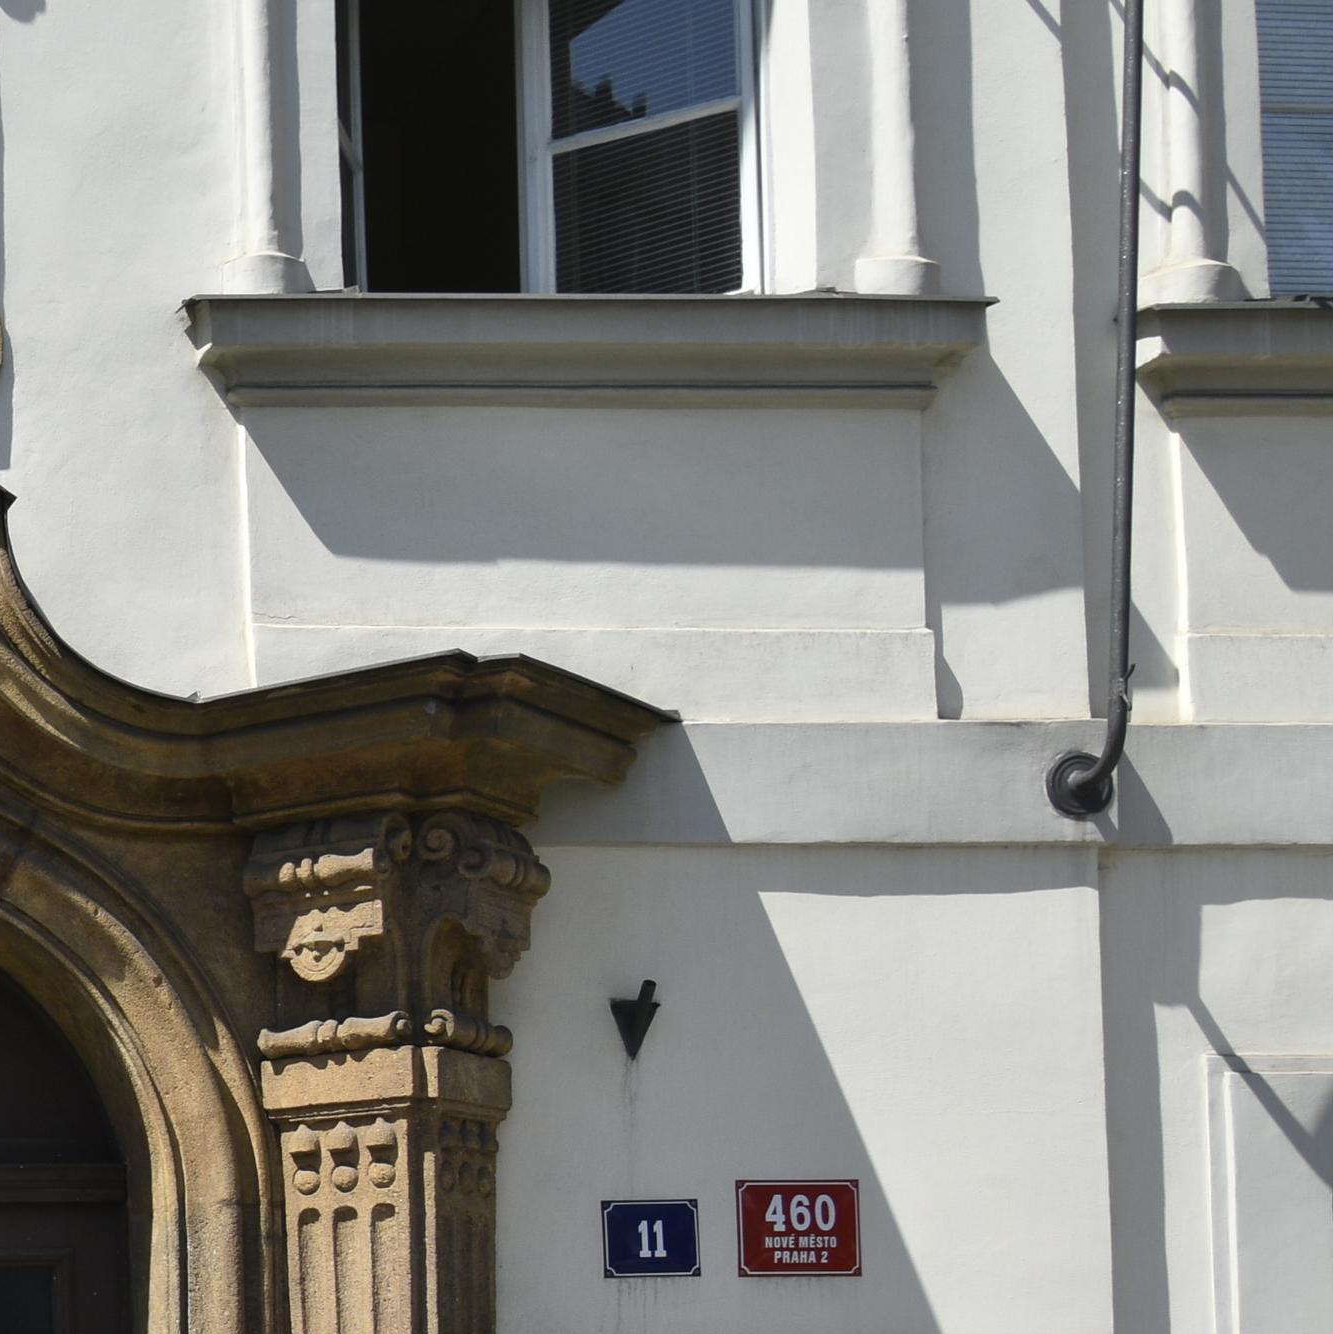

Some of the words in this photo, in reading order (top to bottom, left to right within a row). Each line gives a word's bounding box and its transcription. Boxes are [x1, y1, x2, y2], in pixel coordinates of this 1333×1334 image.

[765, 1194, 836, 1232] 460
[637, 1220, 667, 1258] 11
[765, 1233, 795, 1248] NOVÉ
[799, 1233, 837, 1248] MĚSTO
[773, 1251, 817, 1264] PRAHA
[820, 1251, 829, 1263] 2
